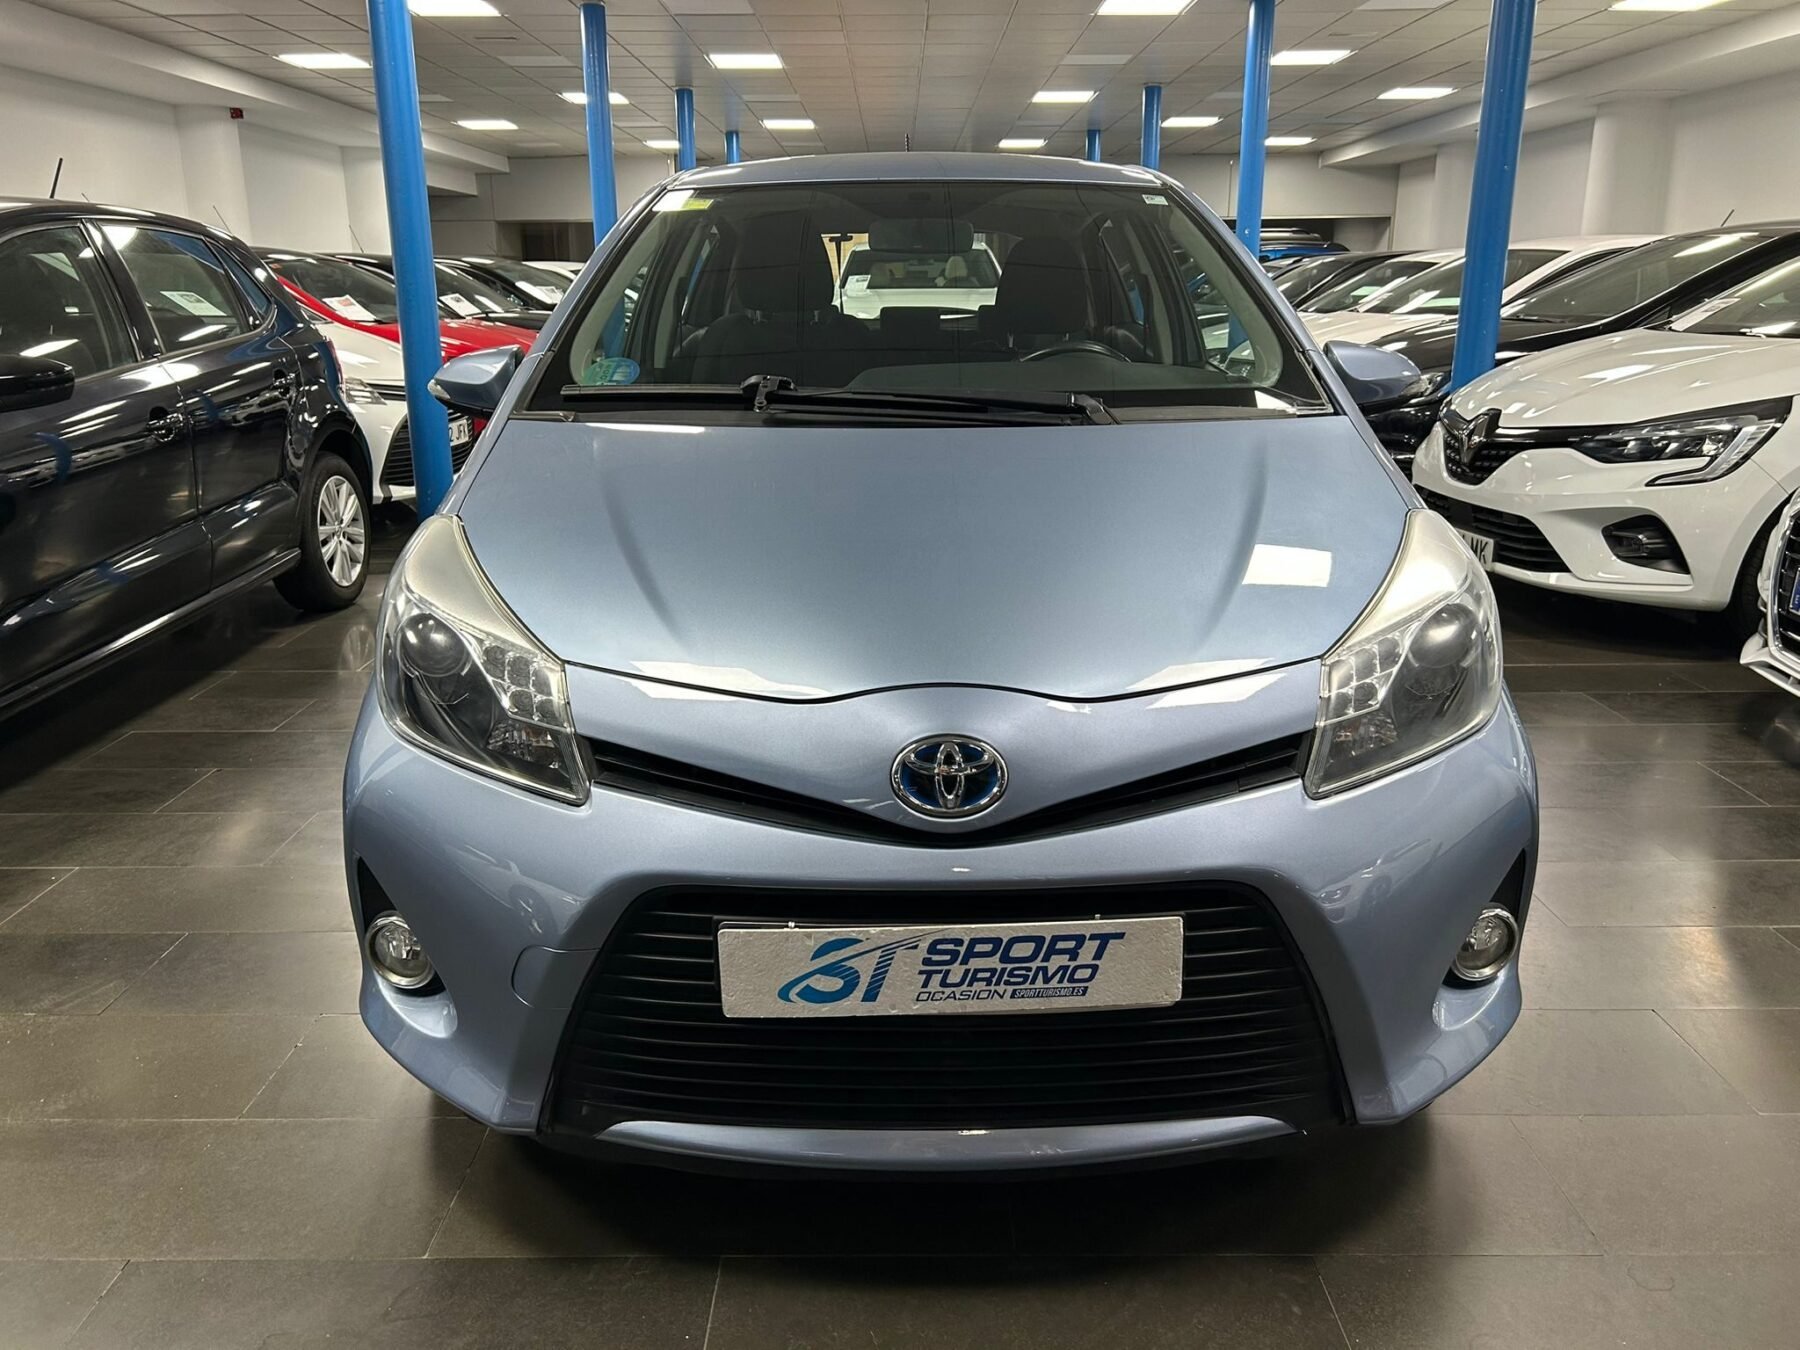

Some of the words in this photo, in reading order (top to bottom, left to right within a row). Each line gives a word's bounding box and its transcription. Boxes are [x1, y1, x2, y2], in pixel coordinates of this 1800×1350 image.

[1462, 534, 1488, 565] MK
[922, 932, 1126, 966] SPORT
[917, 963, 1099, 988] TURISMO
[915, 989, 1007, 1001] OCASION
[1014, 986, 1085, 998] SPORTTURISMO.ES
